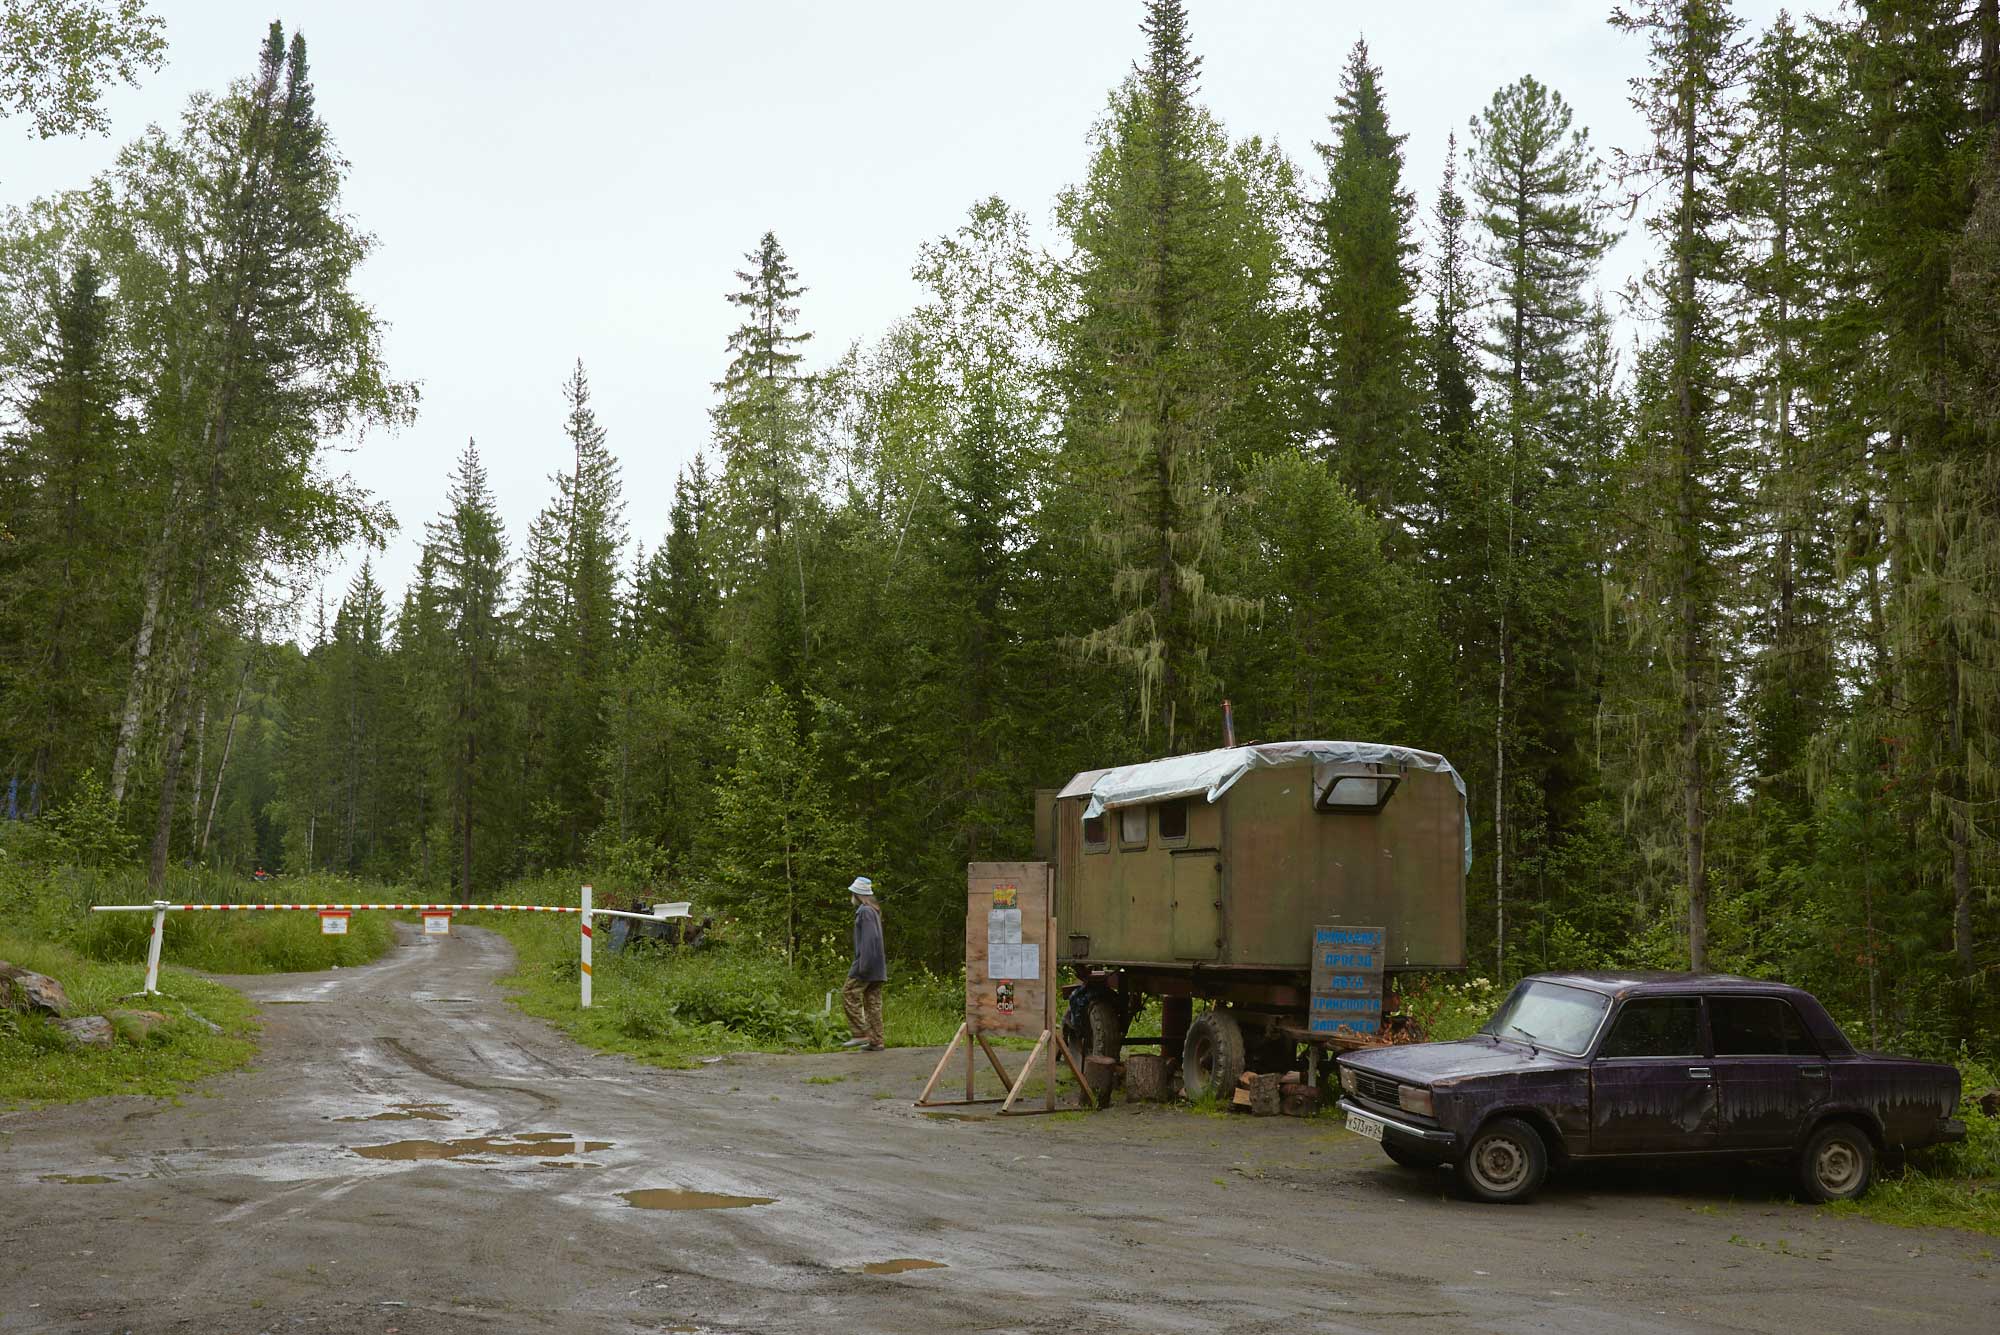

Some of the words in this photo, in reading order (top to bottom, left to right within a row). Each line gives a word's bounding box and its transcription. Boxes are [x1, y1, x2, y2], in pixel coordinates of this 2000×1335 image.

[1325, 953, 1373, 968] ПРОЕЗД
[997, 1001, 1013, 1011] СТОЙ
[1313, 998, 1380, 1010] ТРАНСПОРТА
